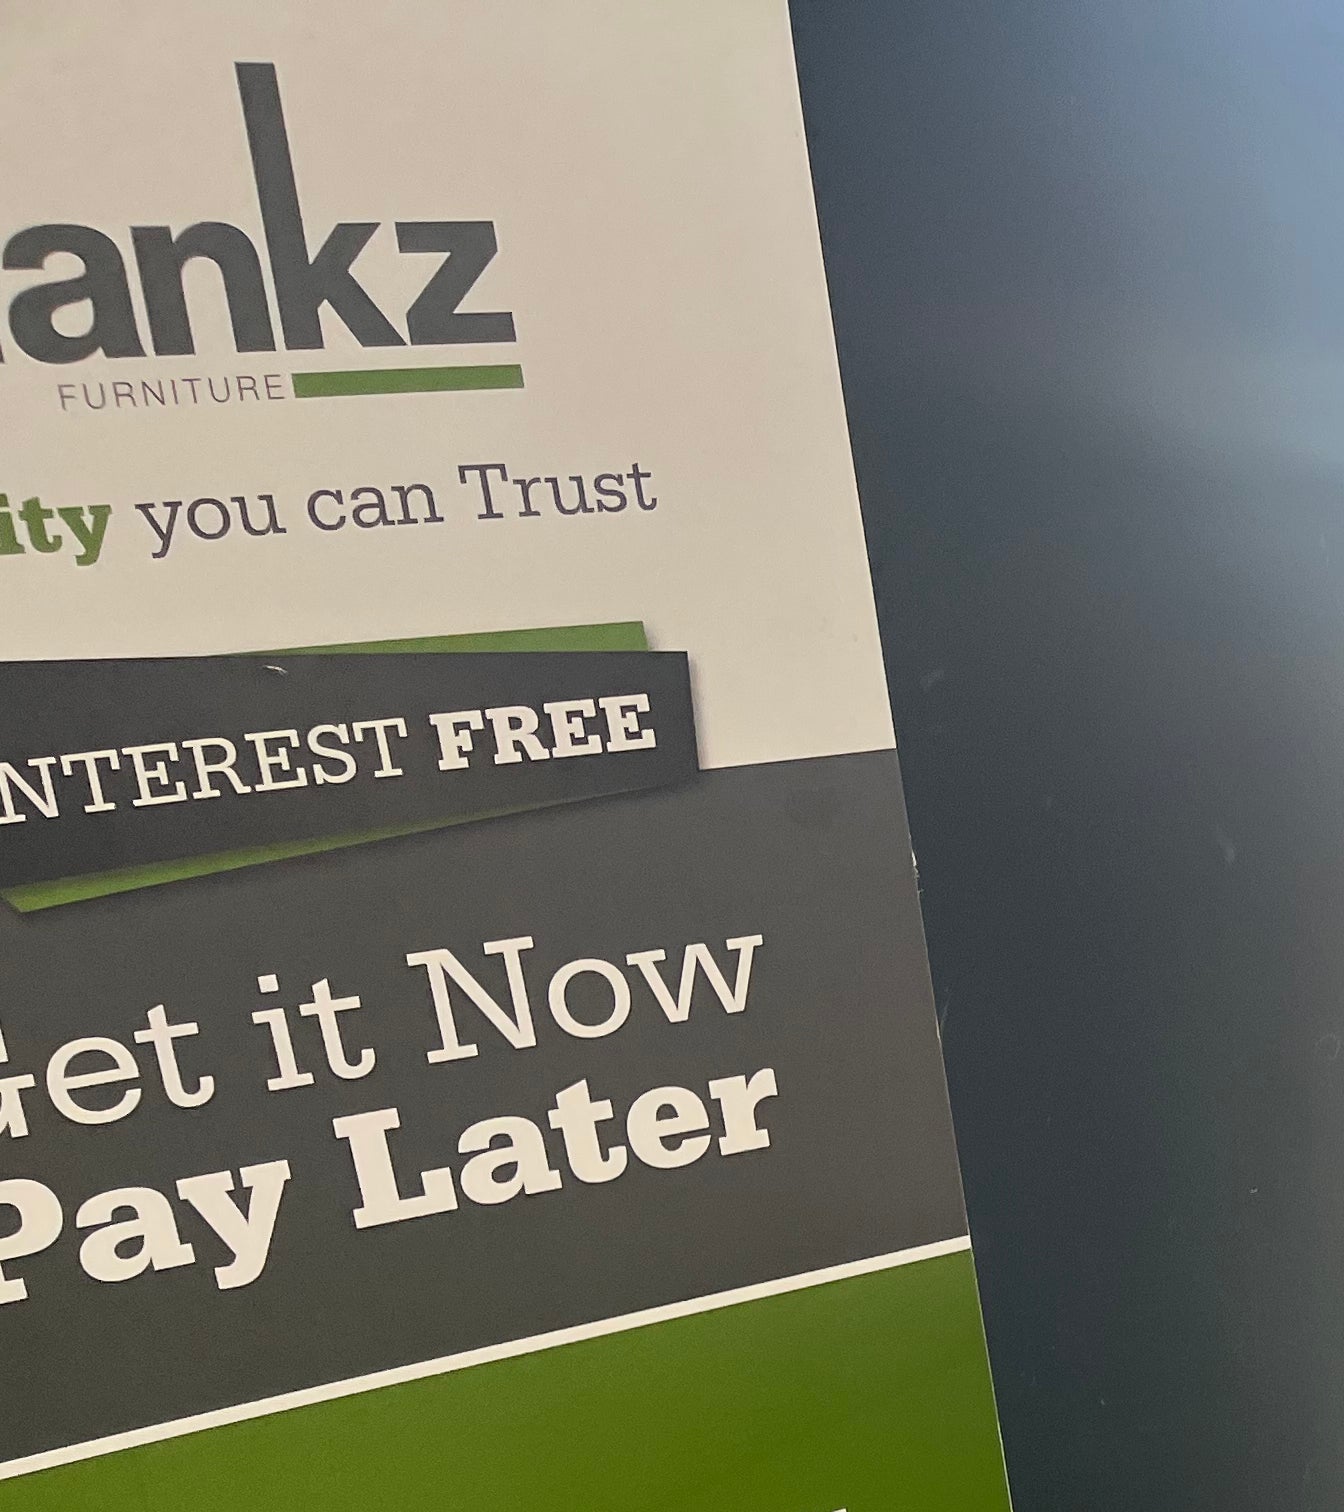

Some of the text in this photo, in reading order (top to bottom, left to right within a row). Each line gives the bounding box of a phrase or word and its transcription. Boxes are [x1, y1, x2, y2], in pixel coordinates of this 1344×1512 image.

[0, 61, 517, 365] ankz
[57, 373, 287, 411] FURNITURE
[135, 488, 287, 559] you
[307, 477, 444, 533] can
[458, 461, 658, 521] Trust
[429, 692, 657, 772] FREE
[252, 973, 376, 1092] it
[406, 934, 763, 1064] Now
[0, 1066, 778, 1305] Pay Later
